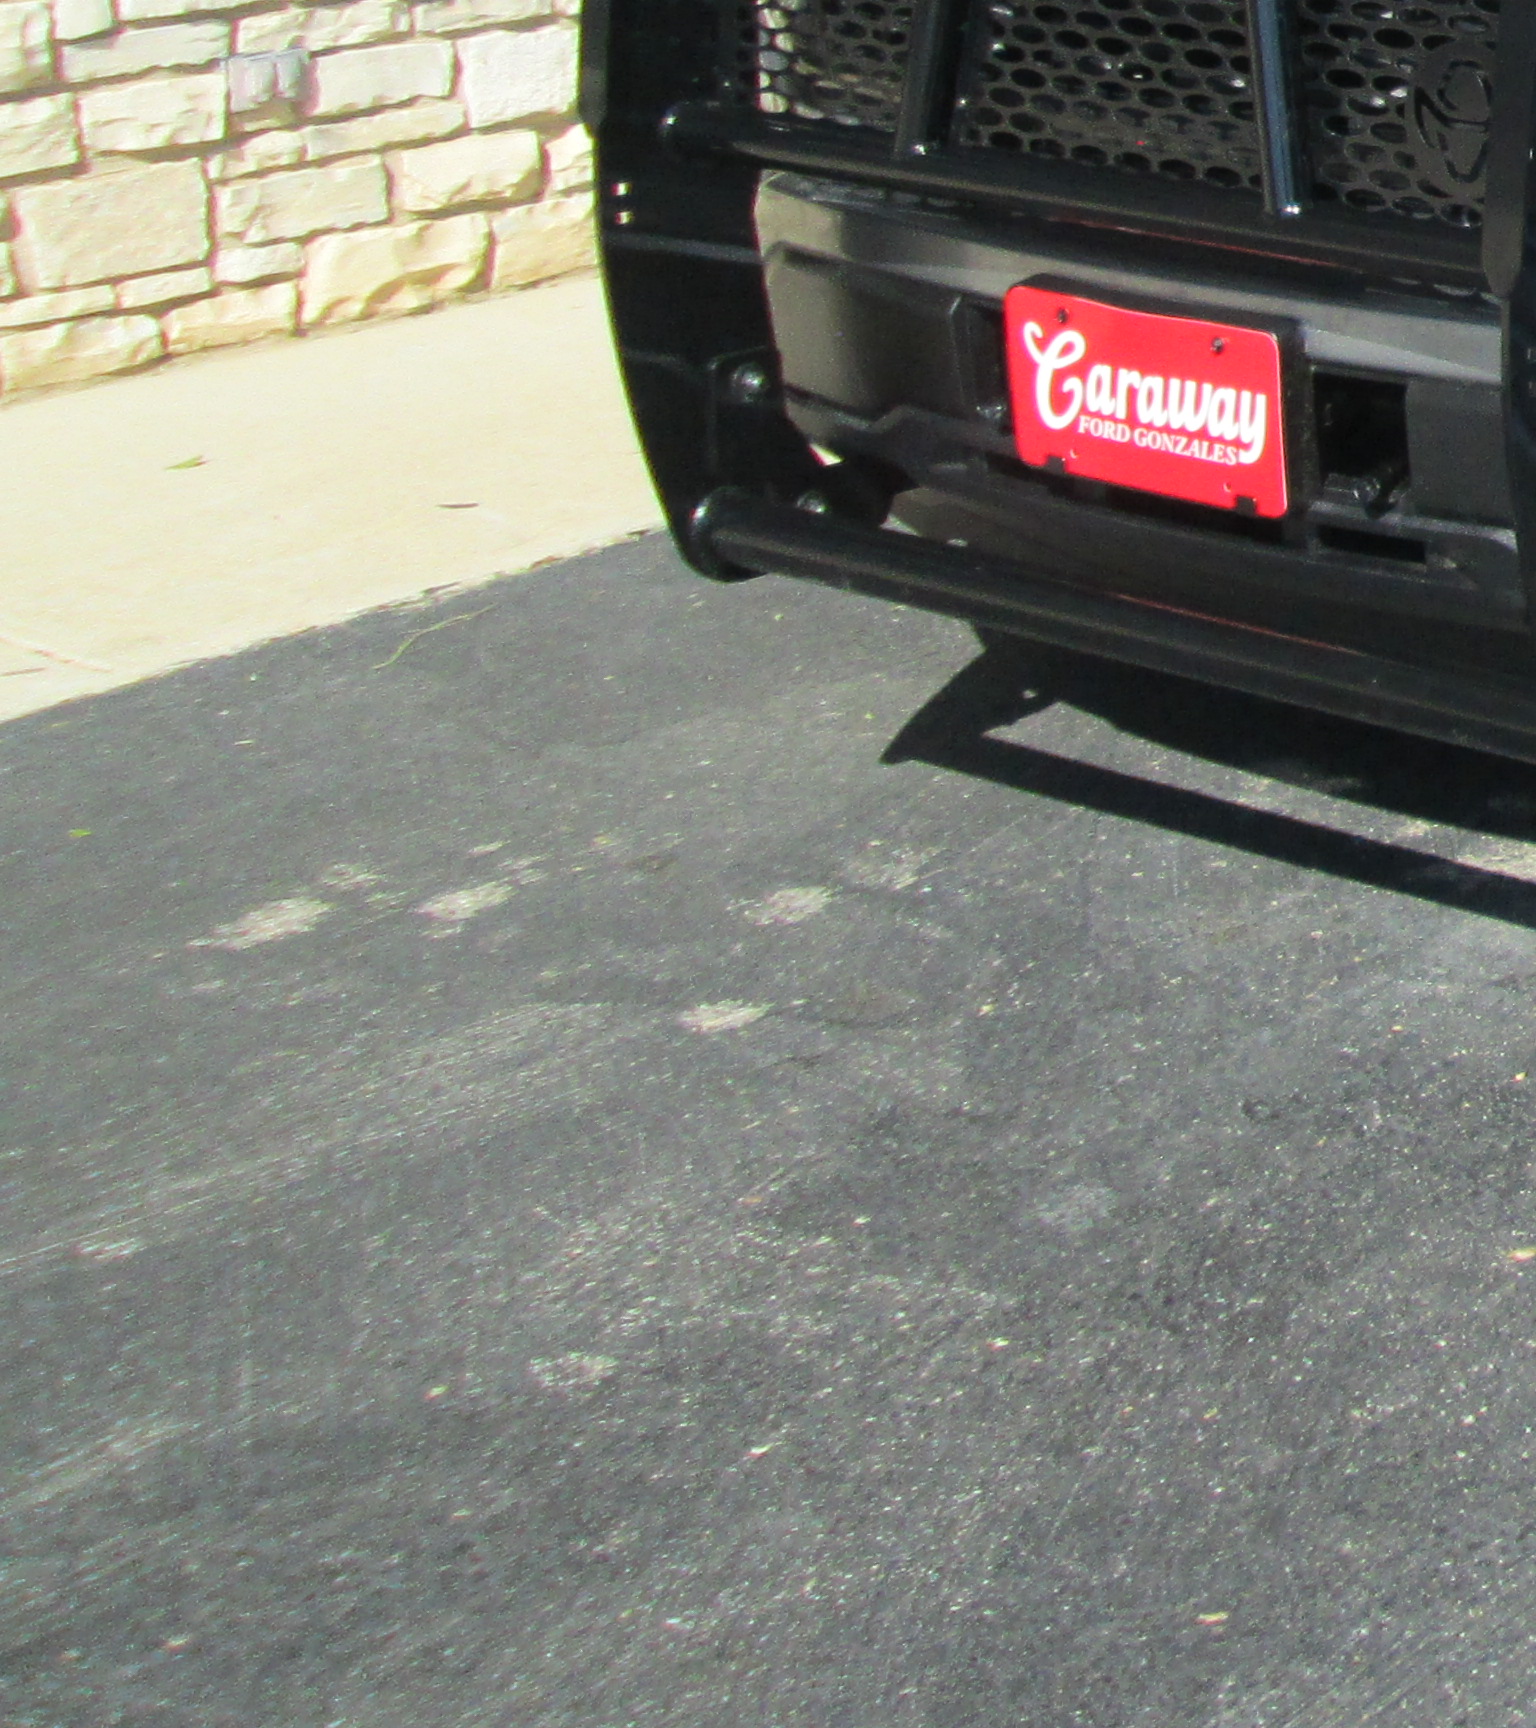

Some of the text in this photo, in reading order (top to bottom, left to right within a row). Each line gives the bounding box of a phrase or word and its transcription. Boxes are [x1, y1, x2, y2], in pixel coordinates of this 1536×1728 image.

[1023, 321, 1267, 464] Caraway
[1078, 415, 1238, 465] FORD GONZALES
